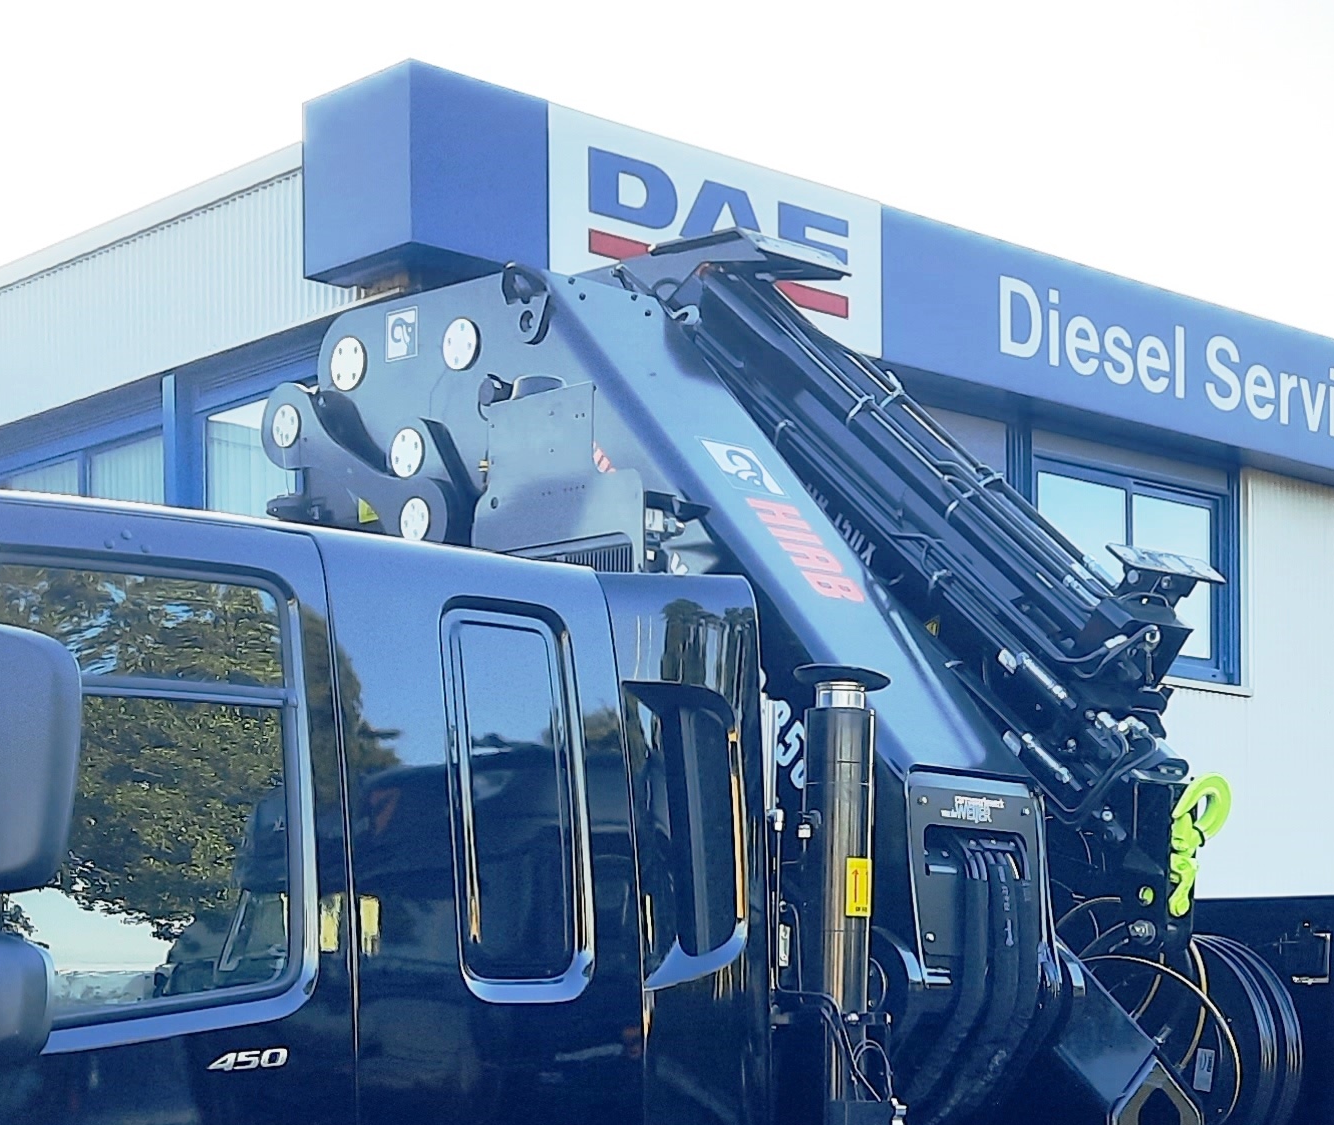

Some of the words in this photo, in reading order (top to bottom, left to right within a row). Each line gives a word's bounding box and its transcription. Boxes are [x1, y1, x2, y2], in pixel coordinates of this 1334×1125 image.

[999, 275, 1185, 399] Diesel
[746, 497, 865, 602] HIAB
[207, 1047, 288, 1071] 450
